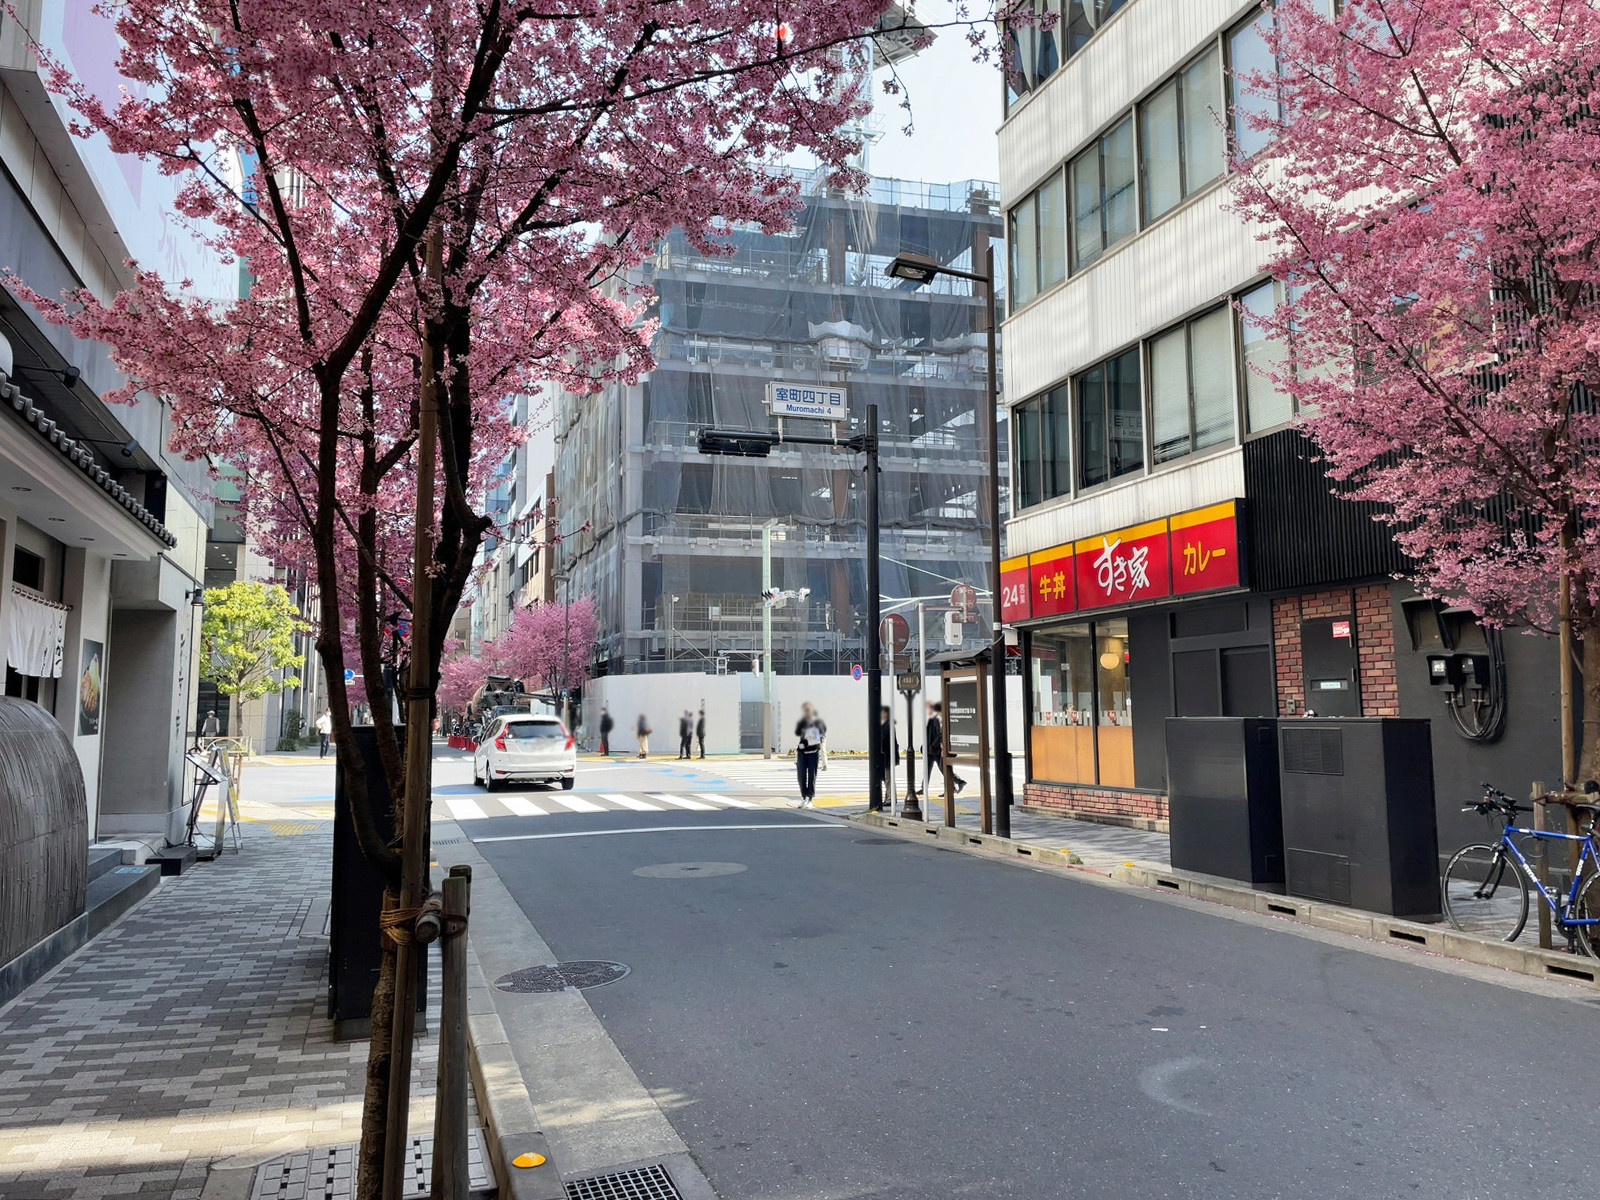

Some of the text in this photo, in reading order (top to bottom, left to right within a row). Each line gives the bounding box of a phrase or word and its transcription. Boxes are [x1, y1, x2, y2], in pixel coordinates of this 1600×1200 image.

[775, 387, 841, 406] 室町四丁目
[786, 404, 824, 414] Muromachi
[1093, 535, 1150, 599] すき家
[1183, 541, 1226, 576] カレー
[1003, 584, 1019, 608] 24
[1039, 570, 1066, 602] 牛丼
